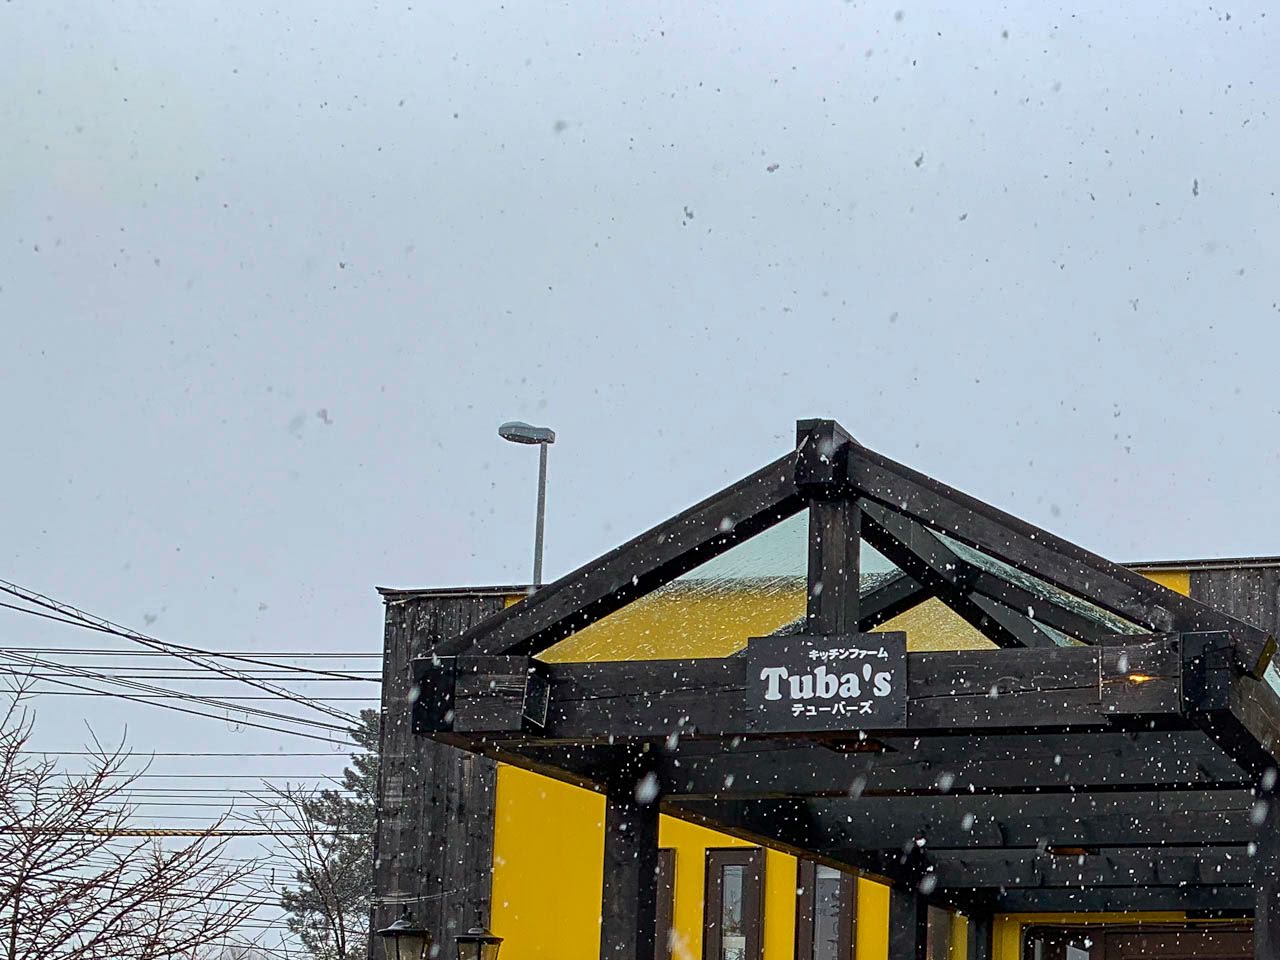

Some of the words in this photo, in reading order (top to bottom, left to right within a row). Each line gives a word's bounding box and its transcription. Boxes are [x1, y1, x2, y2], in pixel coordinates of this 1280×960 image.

[808, 647, 889, 661] キッチンファーム
[760, 663, 893, 701] Tuba's
[791, 701, 874, 717] テューバーズ
